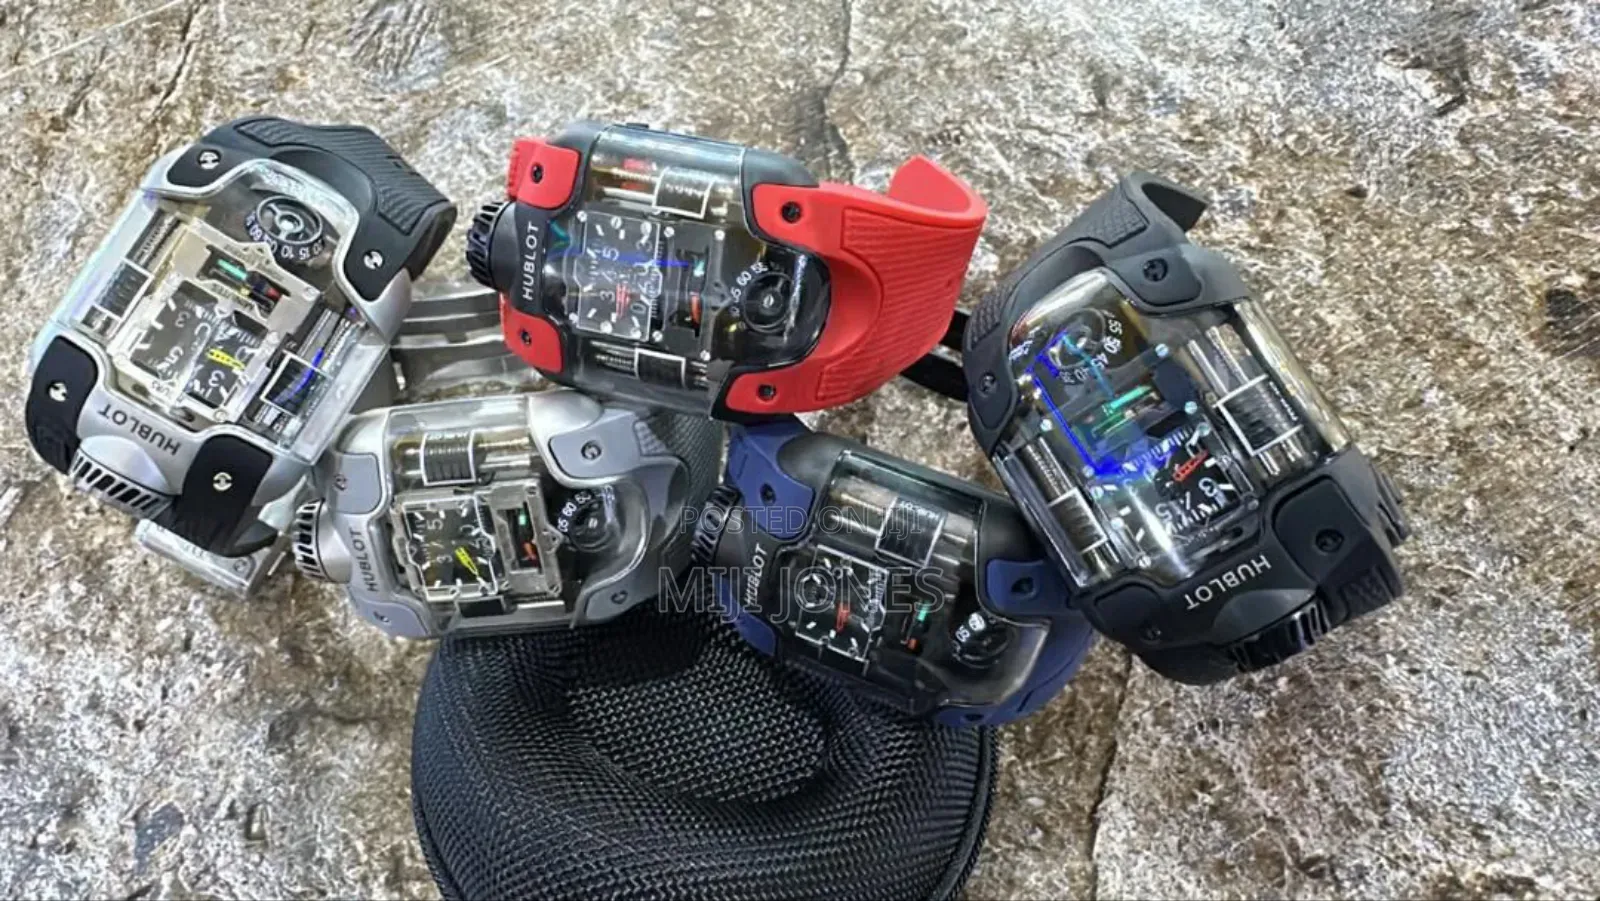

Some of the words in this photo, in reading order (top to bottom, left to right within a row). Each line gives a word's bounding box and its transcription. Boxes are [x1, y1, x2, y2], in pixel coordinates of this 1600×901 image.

[522, 221, 540, 301] HUBLOT
[97, 403, 181, 456] HUBLOT
[350, 527, 379, 592] HUBLOT
[744, 541, 768, 606] HUBLOT
[1184, 554, 1272, 610] HUBLOT
